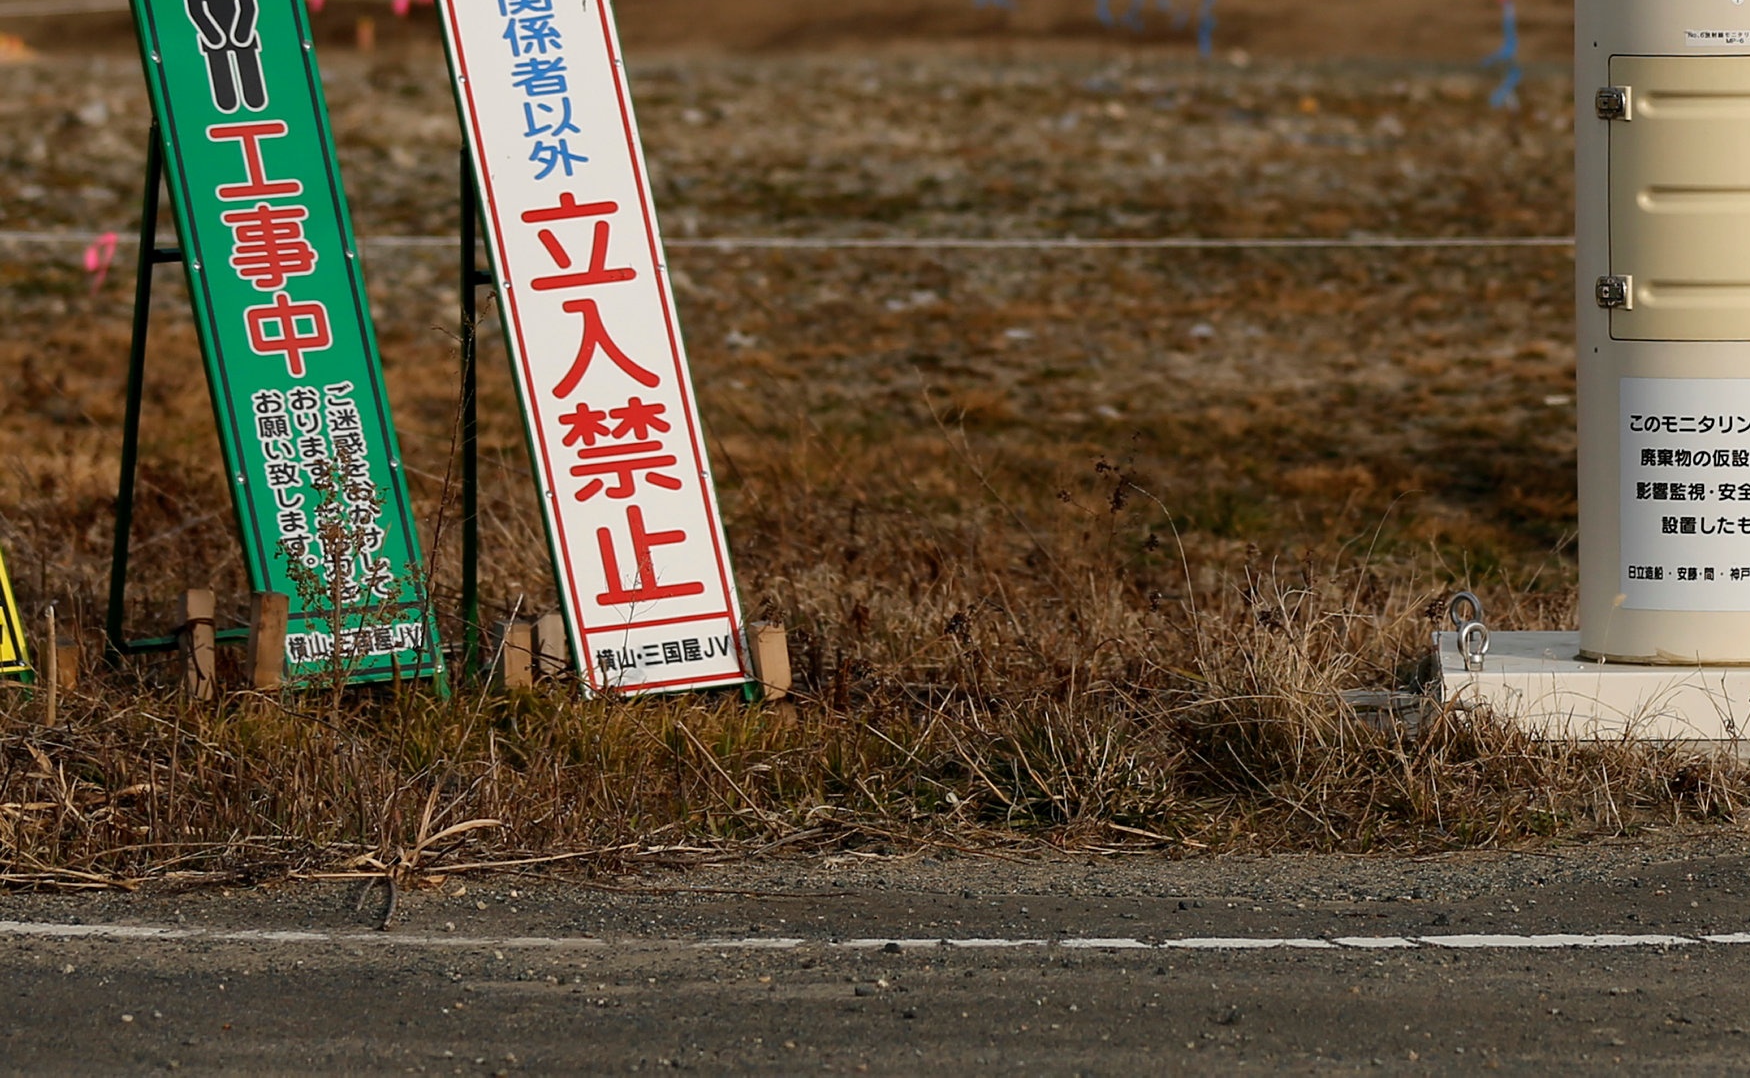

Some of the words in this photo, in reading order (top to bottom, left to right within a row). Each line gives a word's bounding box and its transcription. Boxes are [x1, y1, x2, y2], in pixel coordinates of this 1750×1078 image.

[205, 120, 334, 379] 工事中
[252, 389, 320, 568] お願い致します。
[521, 192, 703, 606] 立入禁止
[595, 634, 732, 673] 横山・三国屋JV
